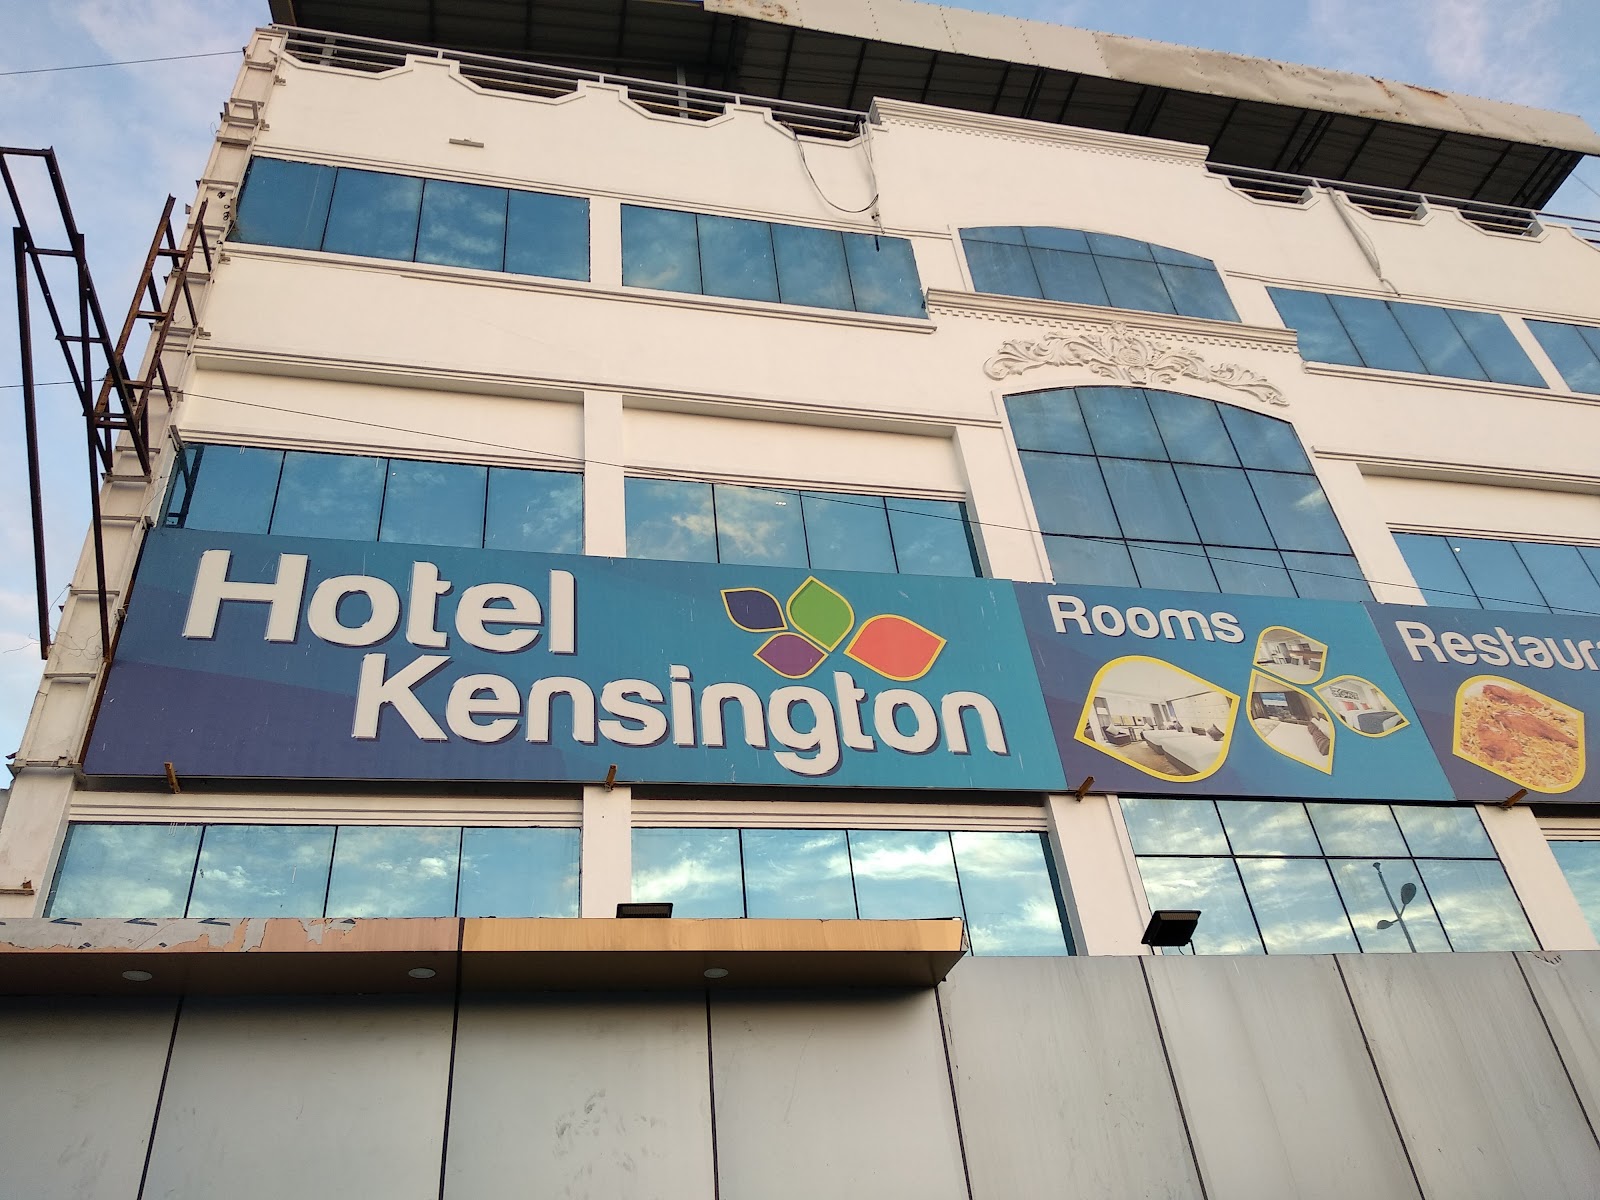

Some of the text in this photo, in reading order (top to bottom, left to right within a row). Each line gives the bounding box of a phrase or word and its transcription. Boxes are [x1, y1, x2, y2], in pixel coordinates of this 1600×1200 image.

[182, 549, 576, 655] Hotel
[1047, 594, 1245, 643] Rooms
[1395, 620, 1600, 671] Restaur
[351, 652, 1010, 777] Kensington
